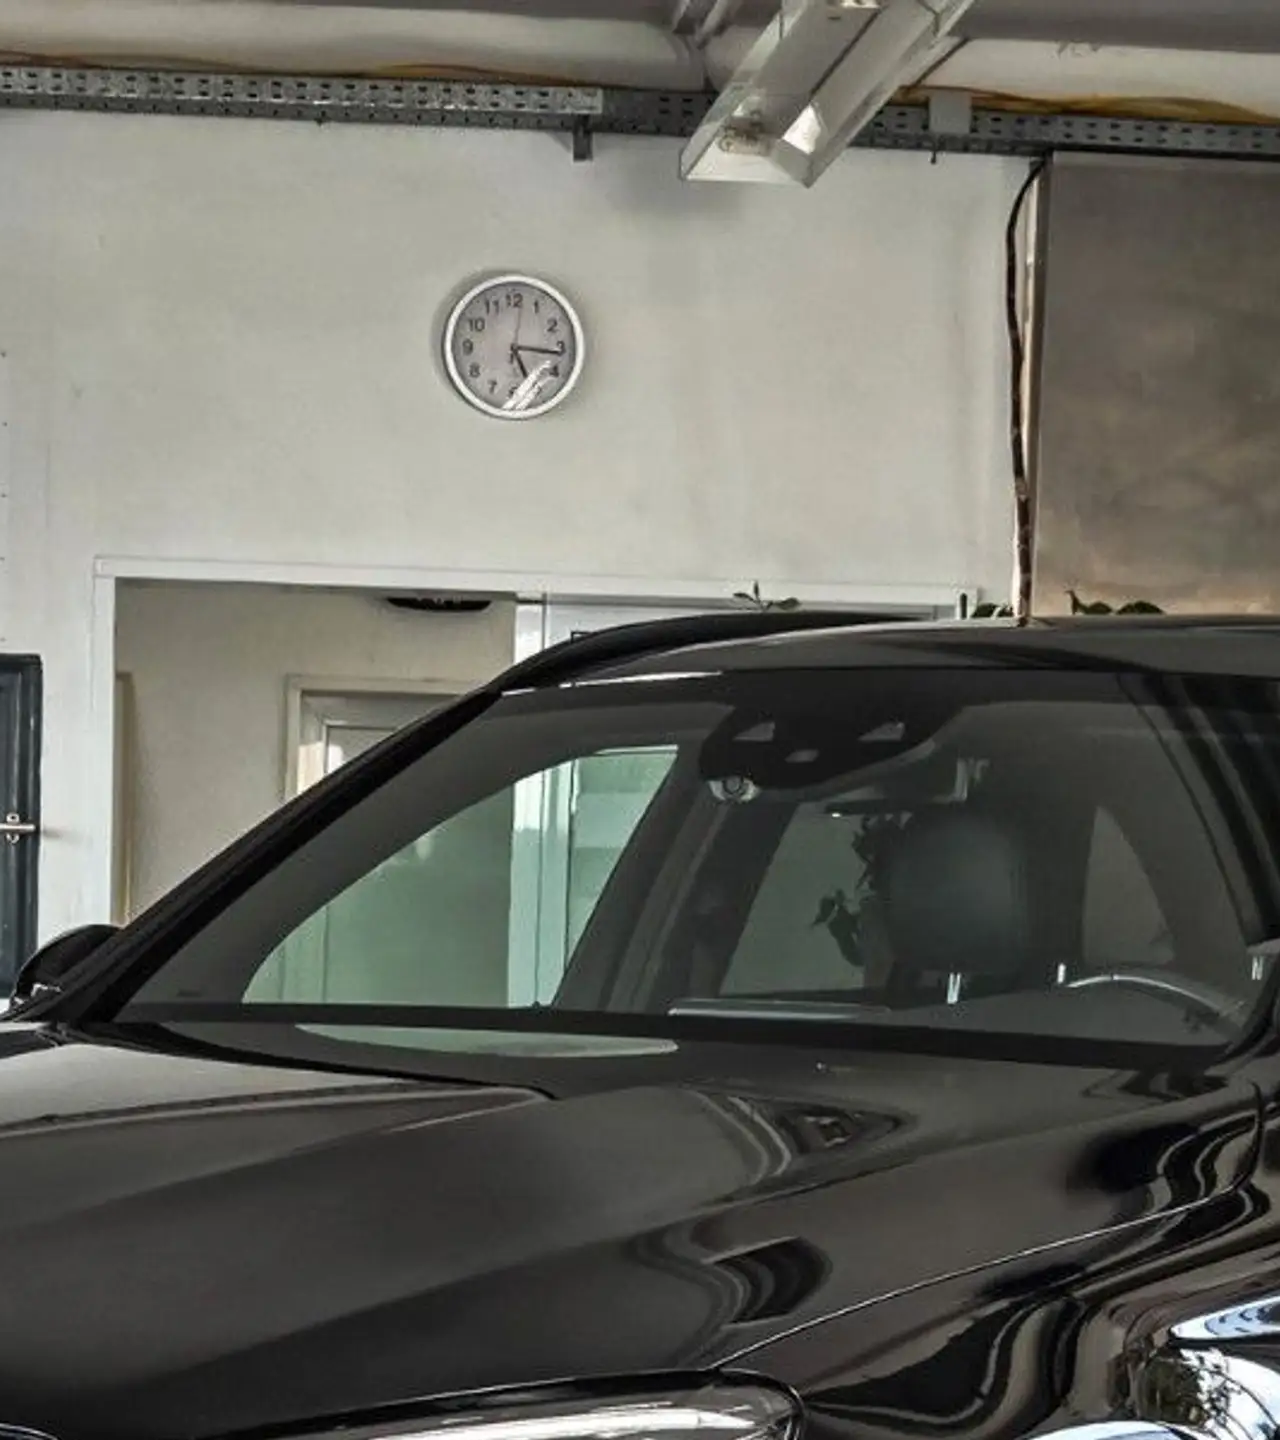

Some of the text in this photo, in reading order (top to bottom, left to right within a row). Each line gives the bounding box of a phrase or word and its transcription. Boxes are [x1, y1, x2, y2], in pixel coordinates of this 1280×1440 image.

[484, 299, 500, 314] 11
[505, 292, 524, 309] 12
[468, 317, 486, 332] 10
[547, 318, 558, 333] 2
[462, 340, 474, 355] 9
[468, 363, 481, 378] 8
[488, 380, 498, 394] 7
